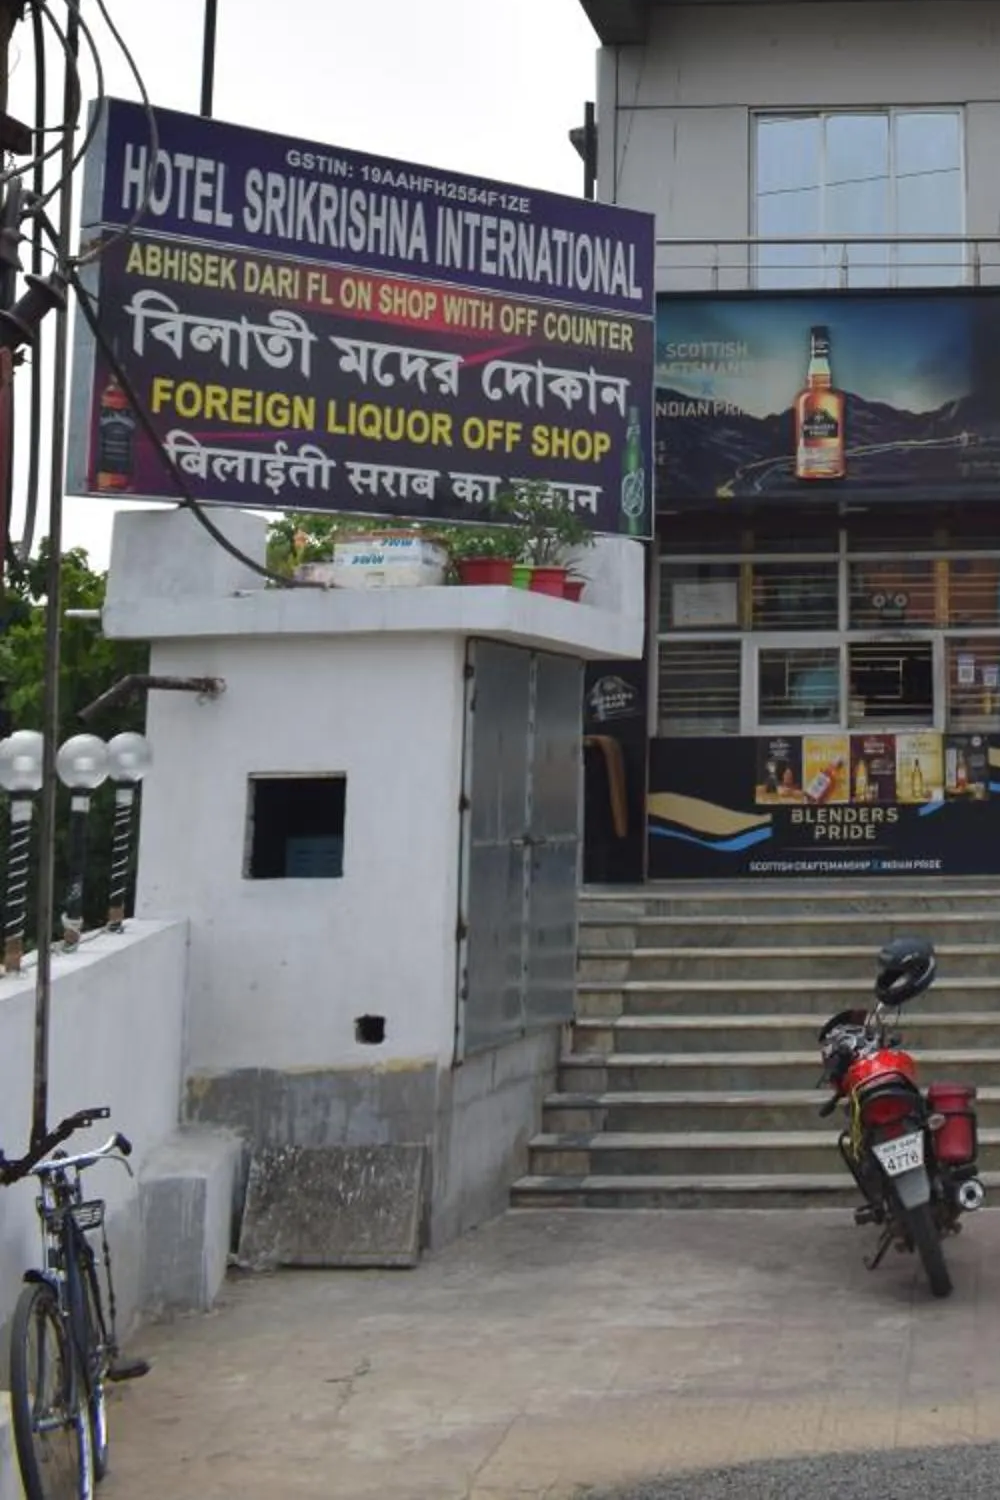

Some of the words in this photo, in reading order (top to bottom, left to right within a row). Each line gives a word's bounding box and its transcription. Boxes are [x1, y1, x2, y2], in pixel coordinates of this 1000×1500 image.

[285, 149, 354, 179] GSTIN:
[121, 143, 233, 228] HOTEL
[243, 168, 428, 263] SRIKRISHNA
[436, 205, 643, 300] INTERNATIONAL
[125, 241, 237, 291] ABHISEK
[243, 260, 300, 301] DARI
[307, 271, 334, 306] FL
[339, 277, 372, 312] ON
[378, 284, 437, 321] SHOP
[443, 293, 494, 331] WITH
[499, 304, 539, 337] OFF
[543, 313, 634, 352] COUNTER
[122, 289, 319, 382] বিলাতী
[329, 336, 465, 398] মদের
[481, 358, 631, 418] দোকান
[151, 376, 316, 431] FOREIGN
[326, 400, 453, 447] LIQUOR
[462, 416, 524, 453] OFF
[531, 424, 612, 463] SHOP
[655, 401, 710, 419] NDIAN
[345, 460, 441, 501] सराब
[449, 471, 503, 504] का
[791, 807, 900, 824] BLENDERS
[813, 824, 877, 841] PRIDE
